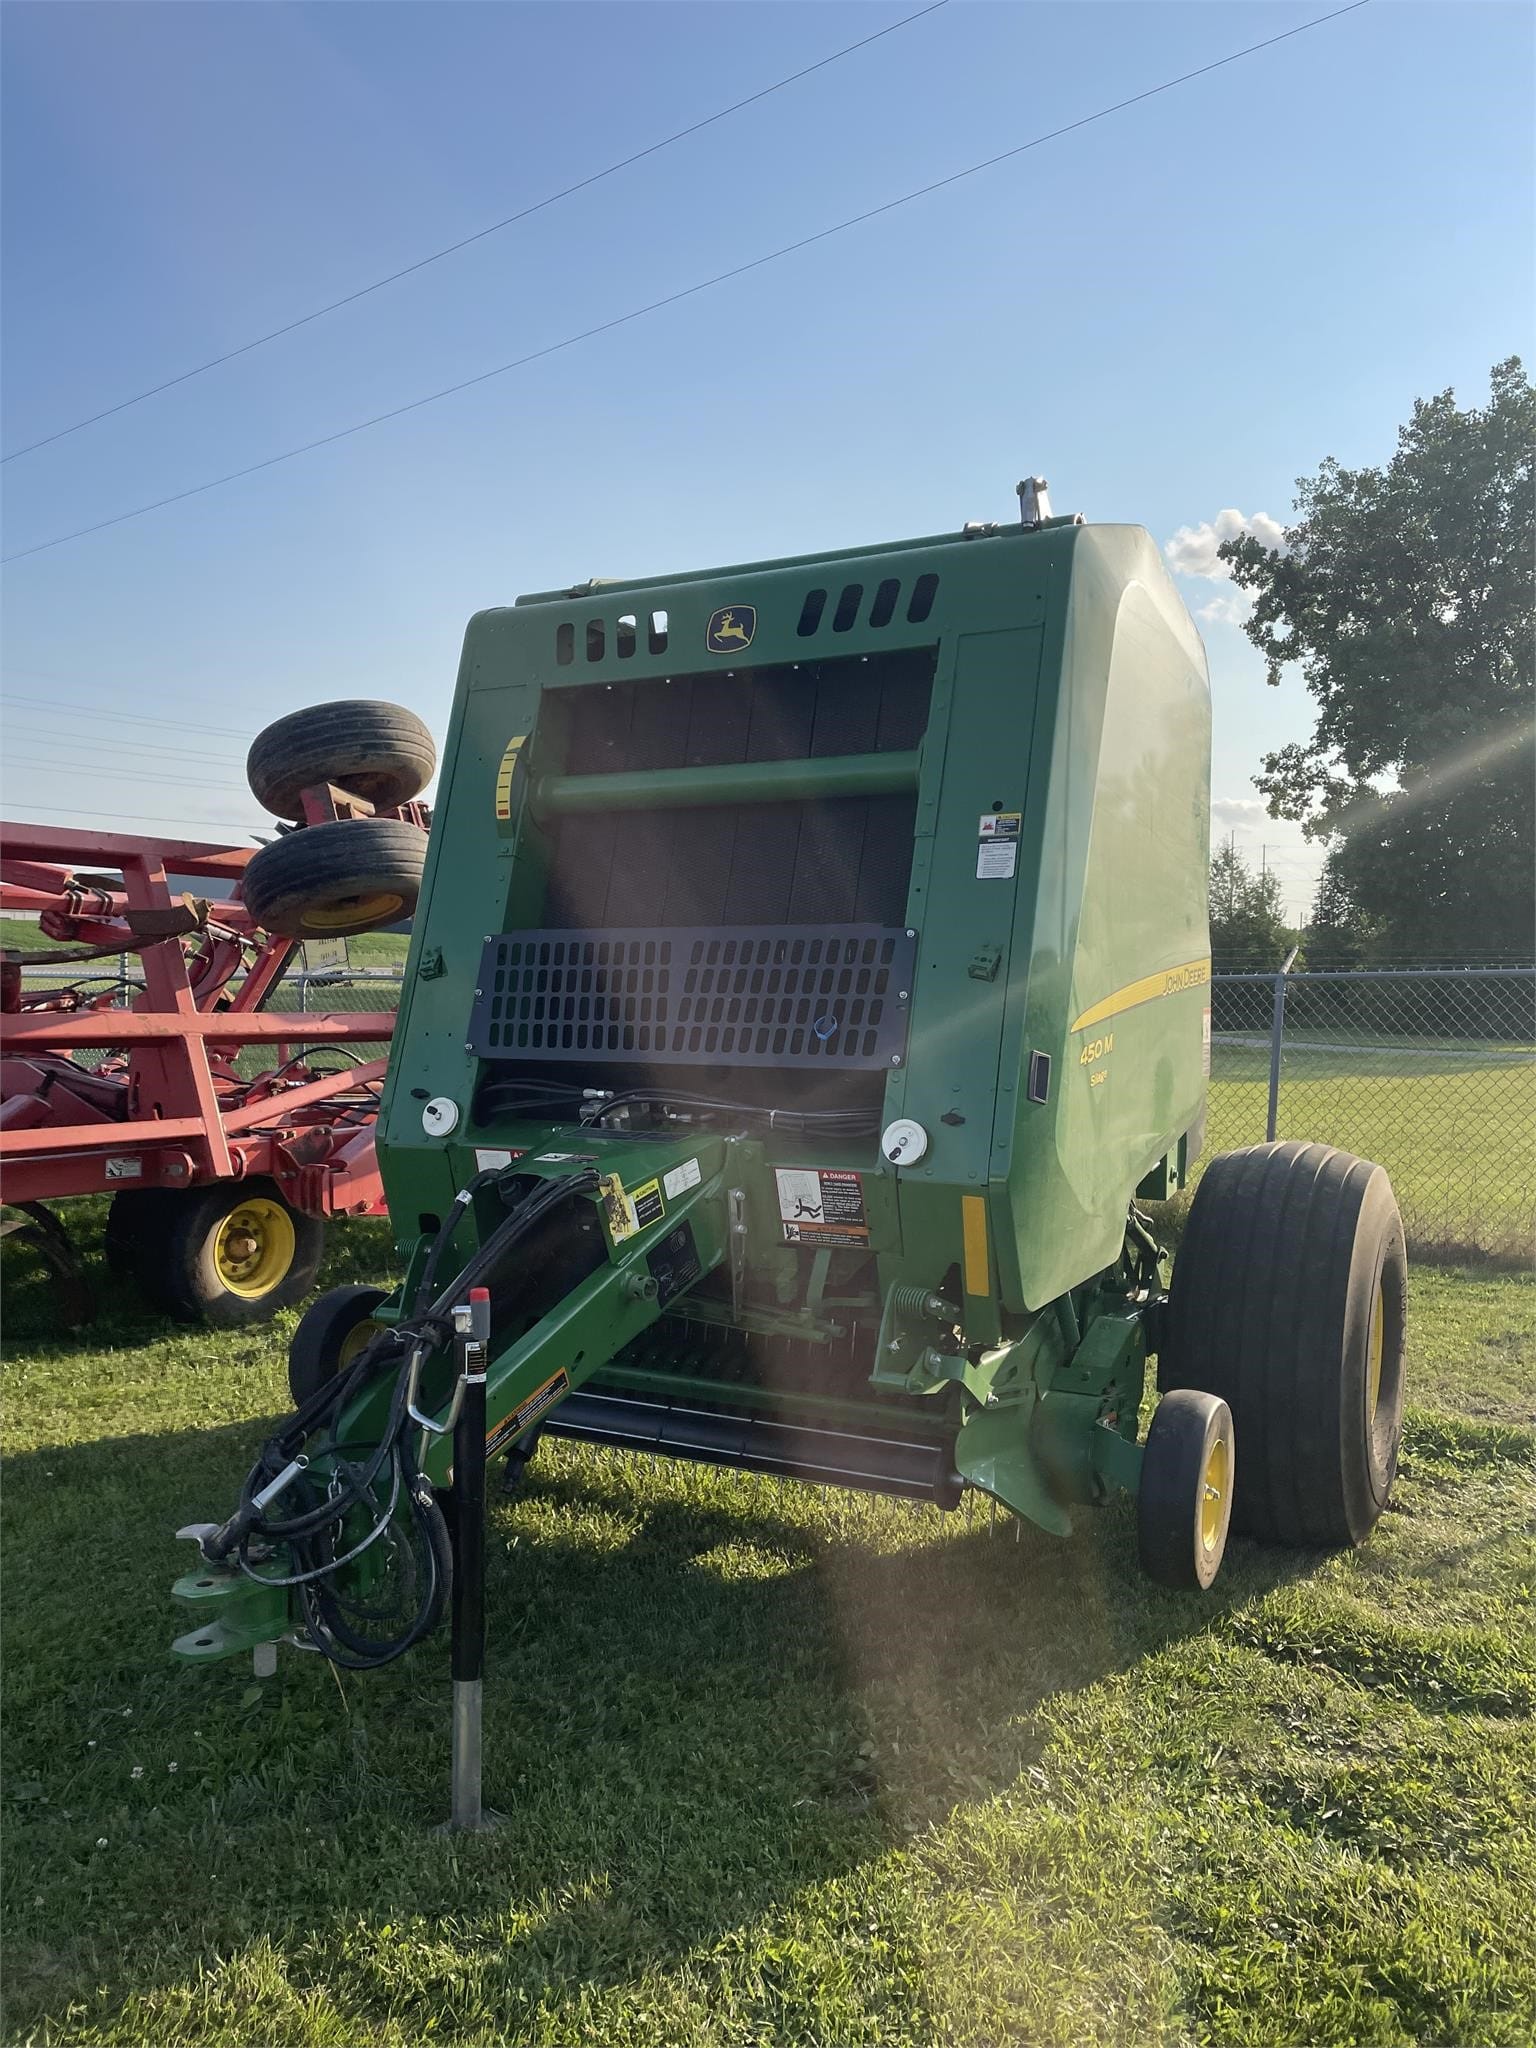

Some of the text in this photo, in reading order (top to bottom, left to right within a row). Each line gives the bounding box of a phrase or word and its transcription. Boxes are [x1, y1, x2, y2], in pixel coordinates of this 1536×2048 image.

[1162, 967, 1206, 994] JOHN DEERE
[829, 1172, 857, 1181] DANGER
